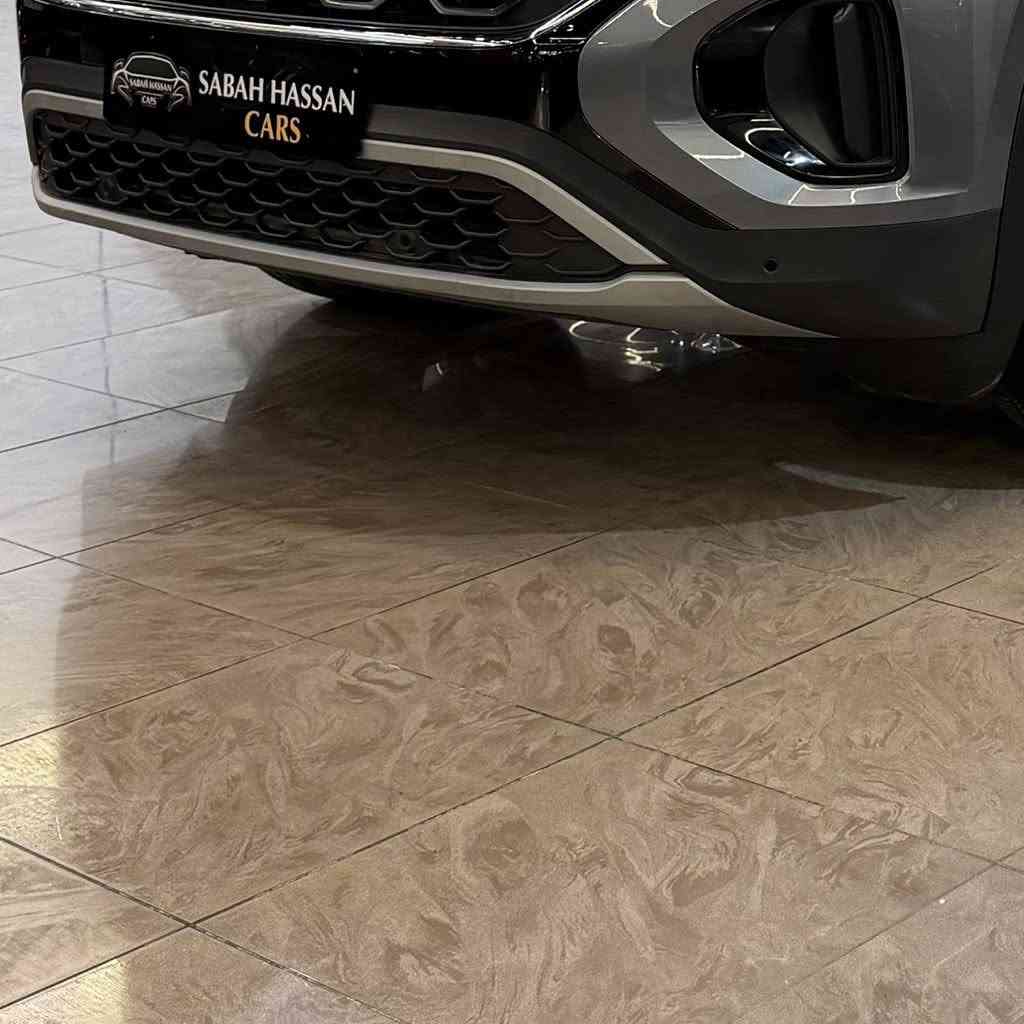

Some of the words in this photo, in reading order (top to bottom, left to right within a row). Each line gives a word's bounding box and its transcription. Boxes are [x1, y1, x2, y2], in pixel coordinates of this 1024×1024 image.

[199, 69, 265, 102] SABAH
[270, 79, 355, 116] HASSAN
[244, 110, 302, 144] CARS
